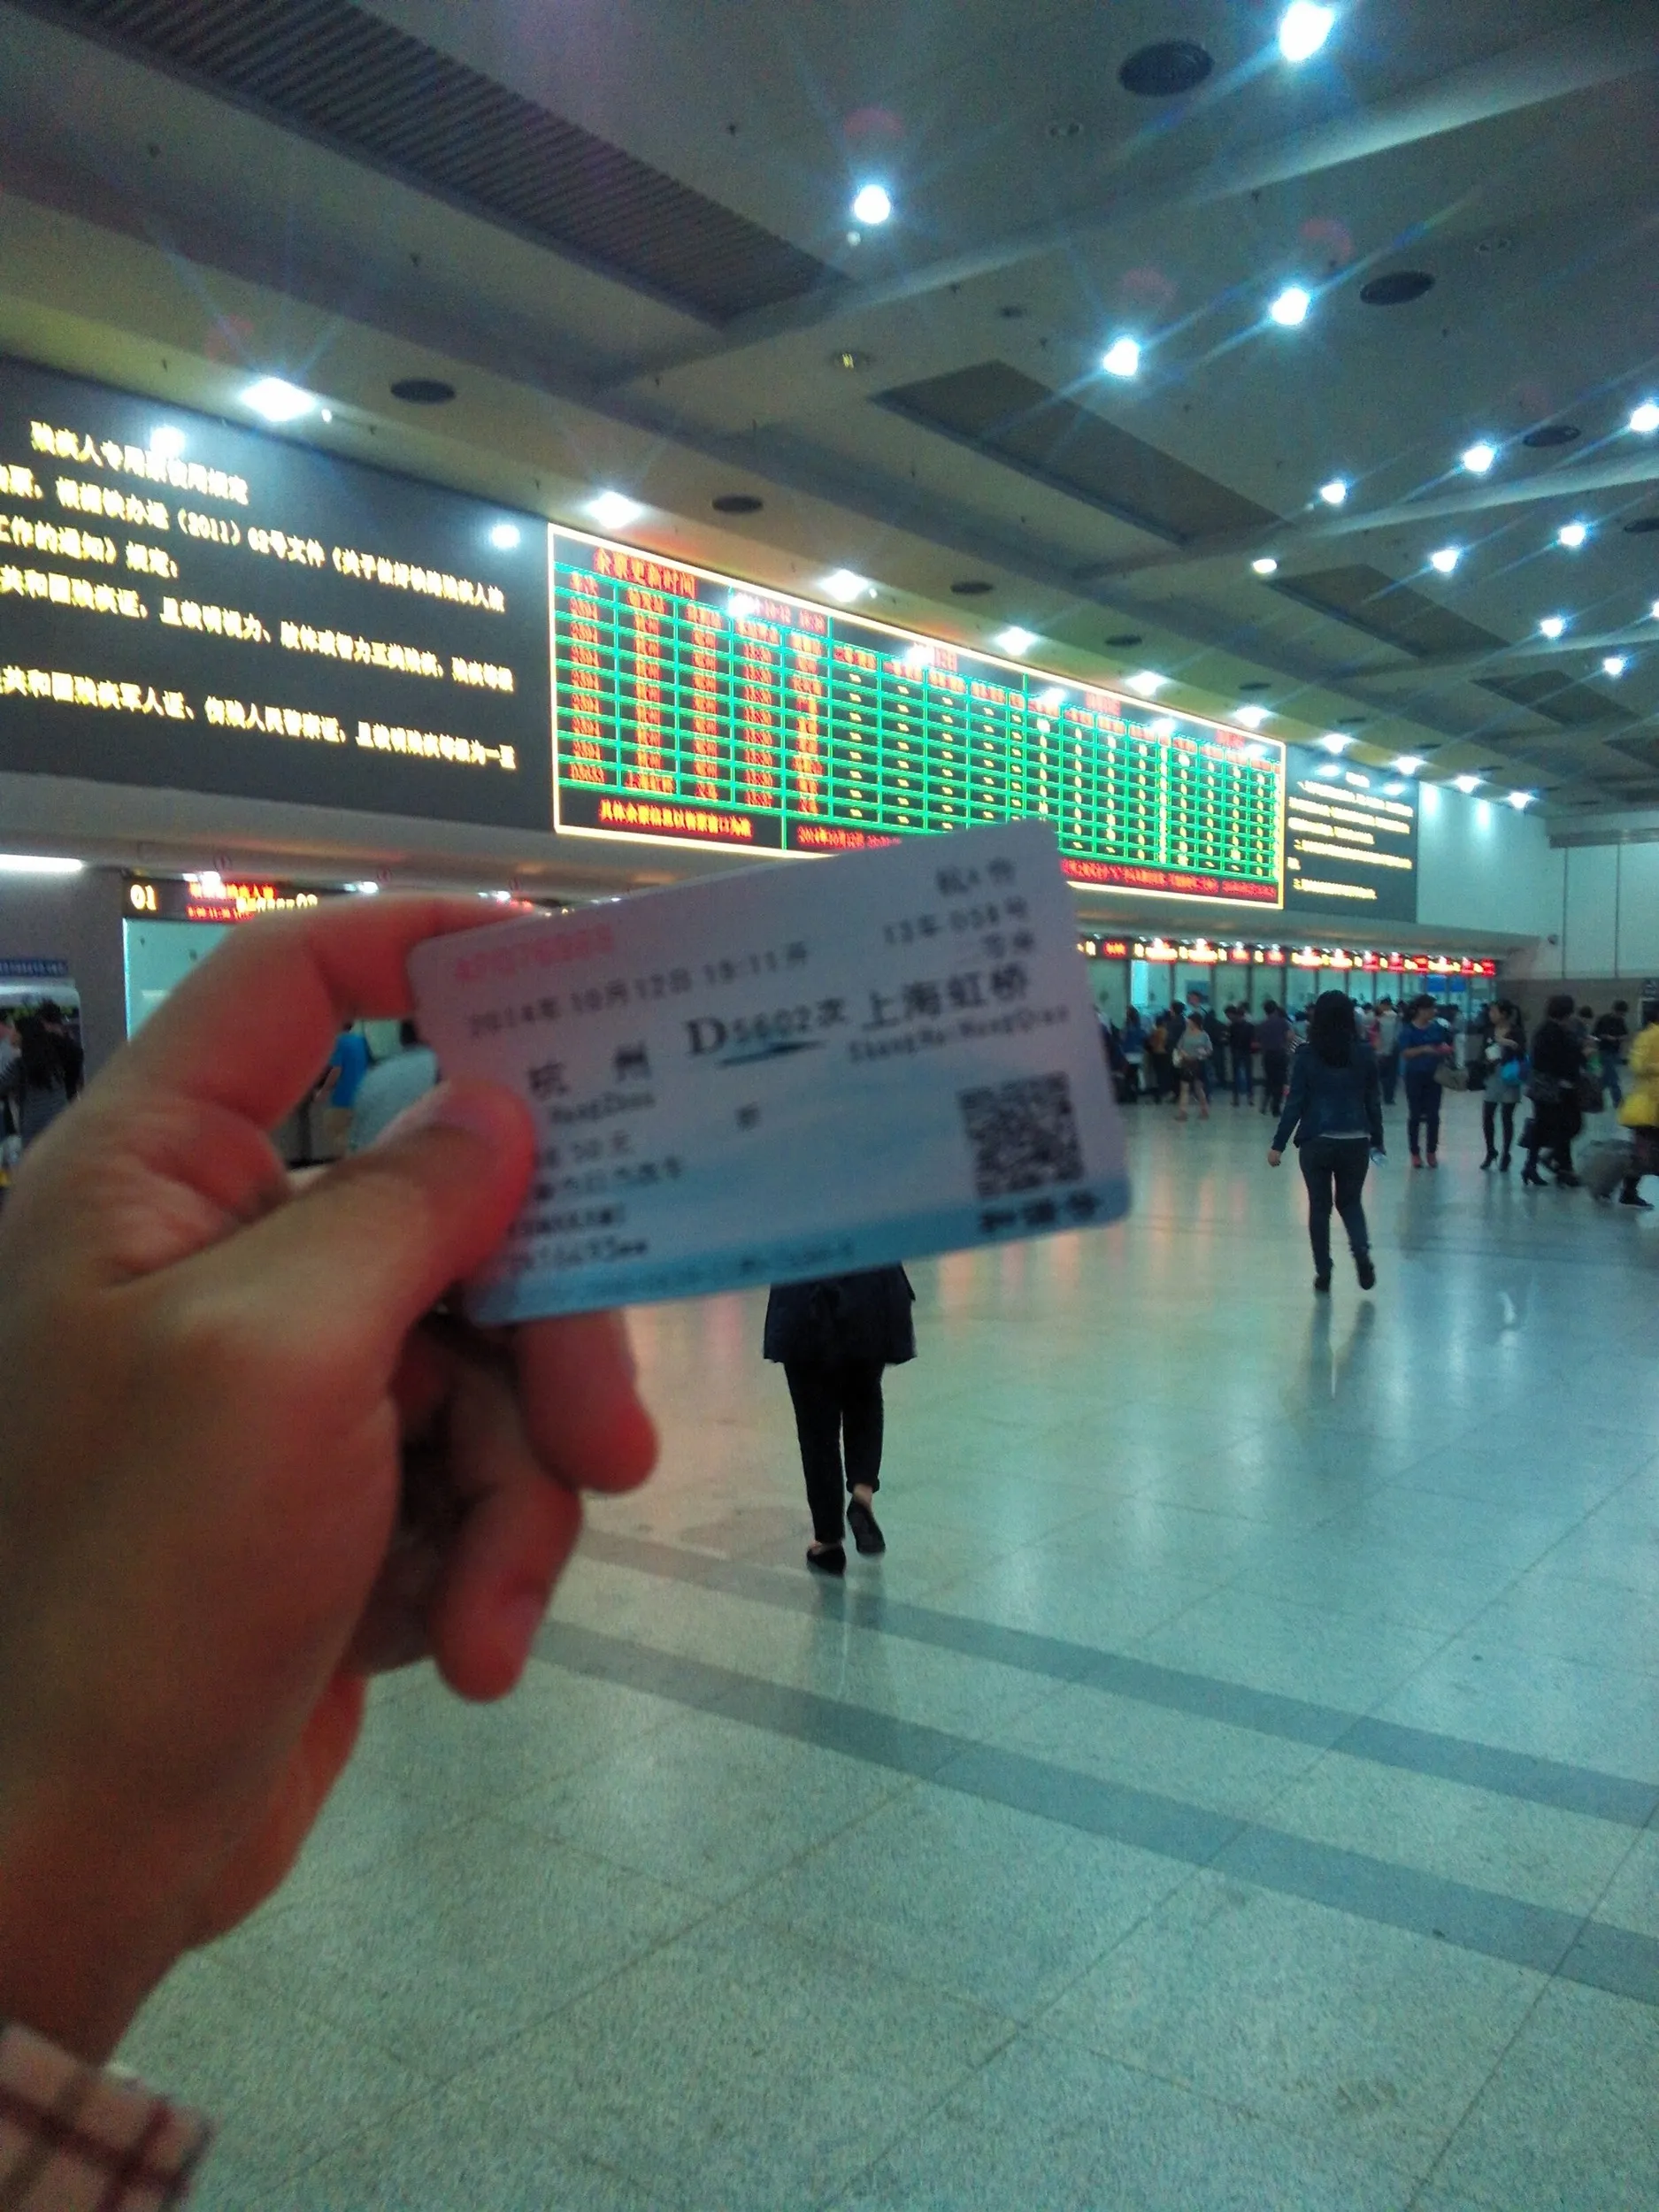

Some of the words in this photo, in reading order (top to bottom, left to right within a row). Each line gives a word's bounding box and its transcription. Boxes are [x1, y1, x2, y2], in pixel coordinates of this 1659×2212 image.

[130, 884, 157, 910] 01
[862, 962, 1029, 1031] 上海虹桥
